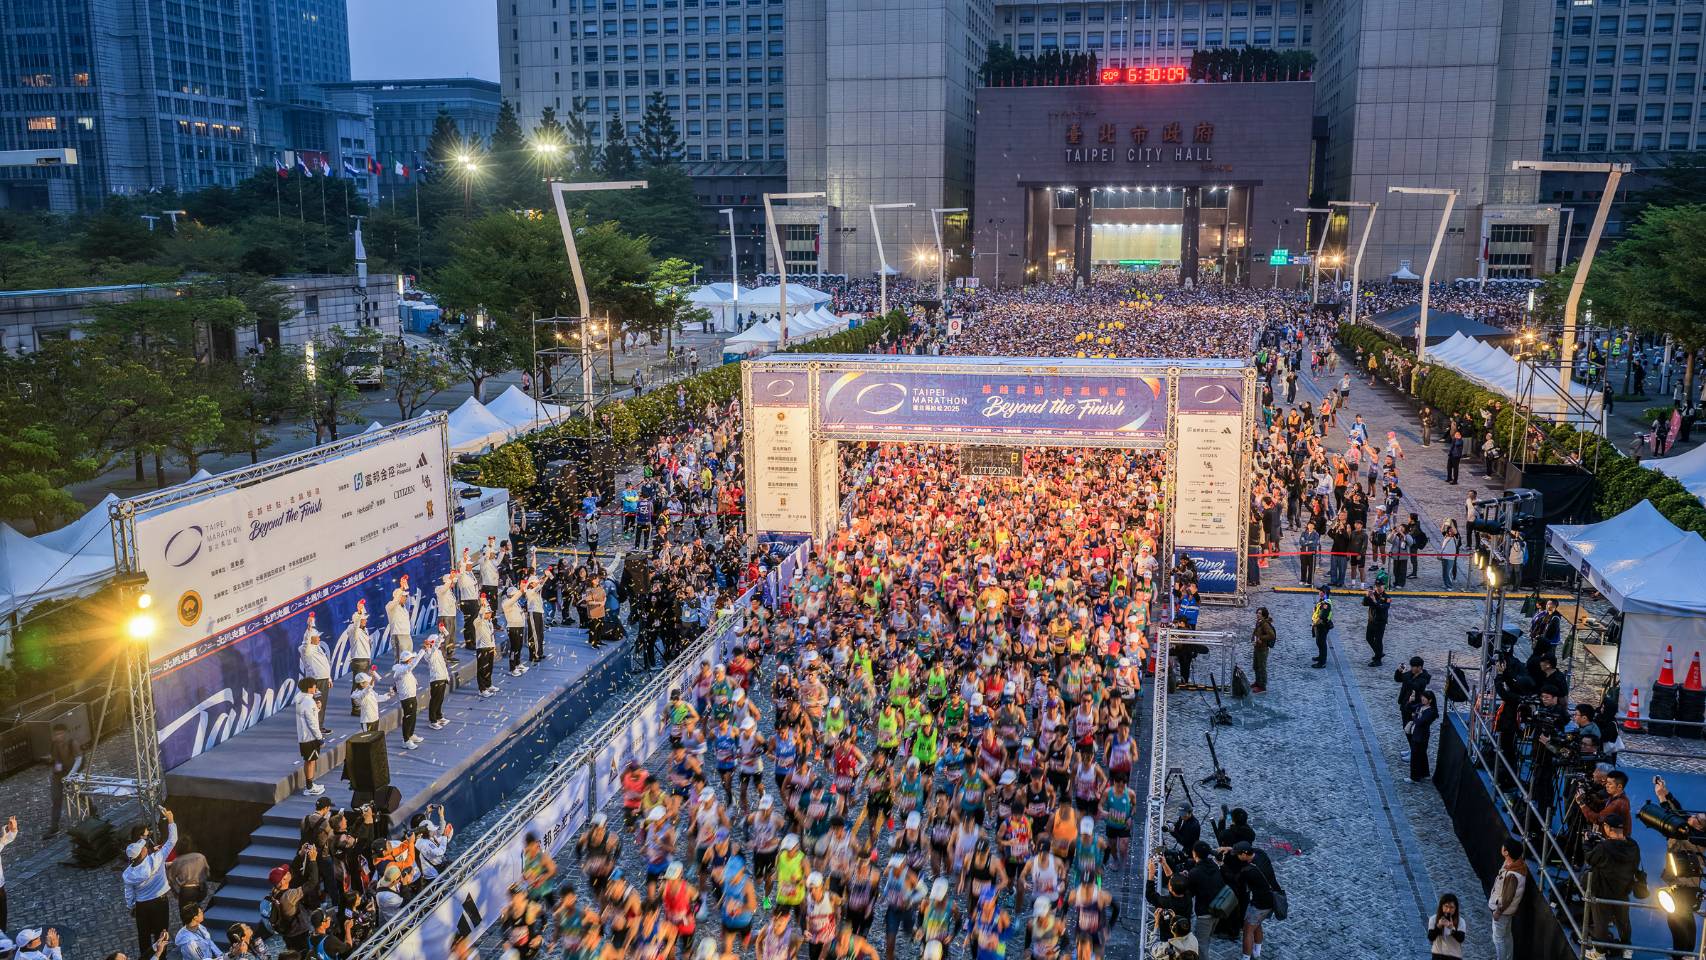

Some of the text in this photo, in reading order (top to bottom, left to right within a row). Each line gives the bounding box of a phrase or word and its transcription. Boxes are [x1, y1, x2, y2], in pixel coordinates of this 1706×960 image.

[1128, 67, 1184, 81] 6:30:09
[1065, 121, 1214, 145] 臺北市政府
[1066, 148, 1213, 162] TAIPEI CITY HALL
[912, 388, 945, 396] TAIPEI
[912, 396, 968, 405] MARATHON
[982, 395, 1126, 420] Beyond the Finish
[365, 465, 396, 487] 富邦金控
[971, 465, 1012, 475] CITIZEN
[393, 484, 417, 499] CITIZEN
[249, 498, 323, 541] Beyond the Finish
[206, 525, 242, 543] MARATHON
